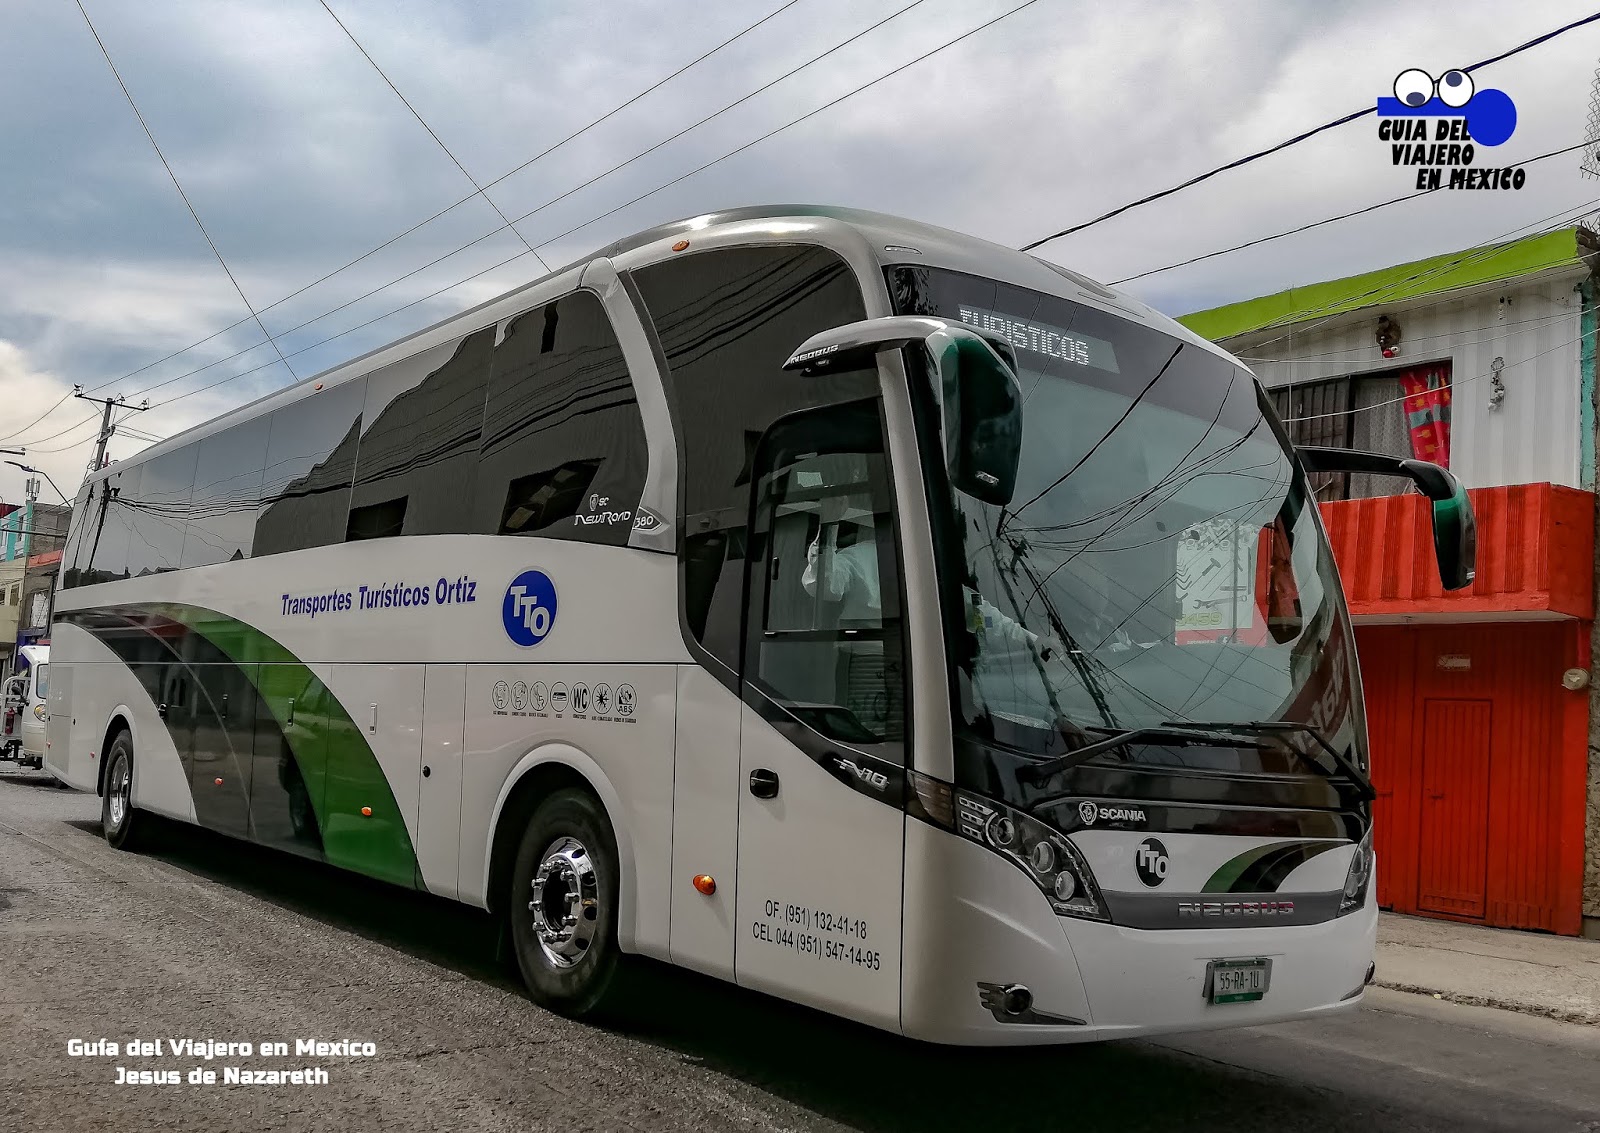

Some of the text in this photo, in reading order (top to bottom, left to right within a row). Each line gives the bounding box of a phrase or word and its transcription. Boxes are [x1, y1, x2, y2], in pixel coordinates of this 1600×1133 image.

[281, 575, 477, 619] Transportes Turísticos Ortiz
[510, 585, 550, 637] TTO
[573, 688, 588, 709] WC
[618, 705, 633, 715] ABS
[1099, 807, 1147, 822] SCANIA
[1137, 844, 1170, 879] TTO
[765, 899, 867, 939] OF. (951) 132-41-18
[1177, 901, 1295, 917] NEOBUS
[752, 921, 880, 971] CEL 044 (951) 547-14-95
